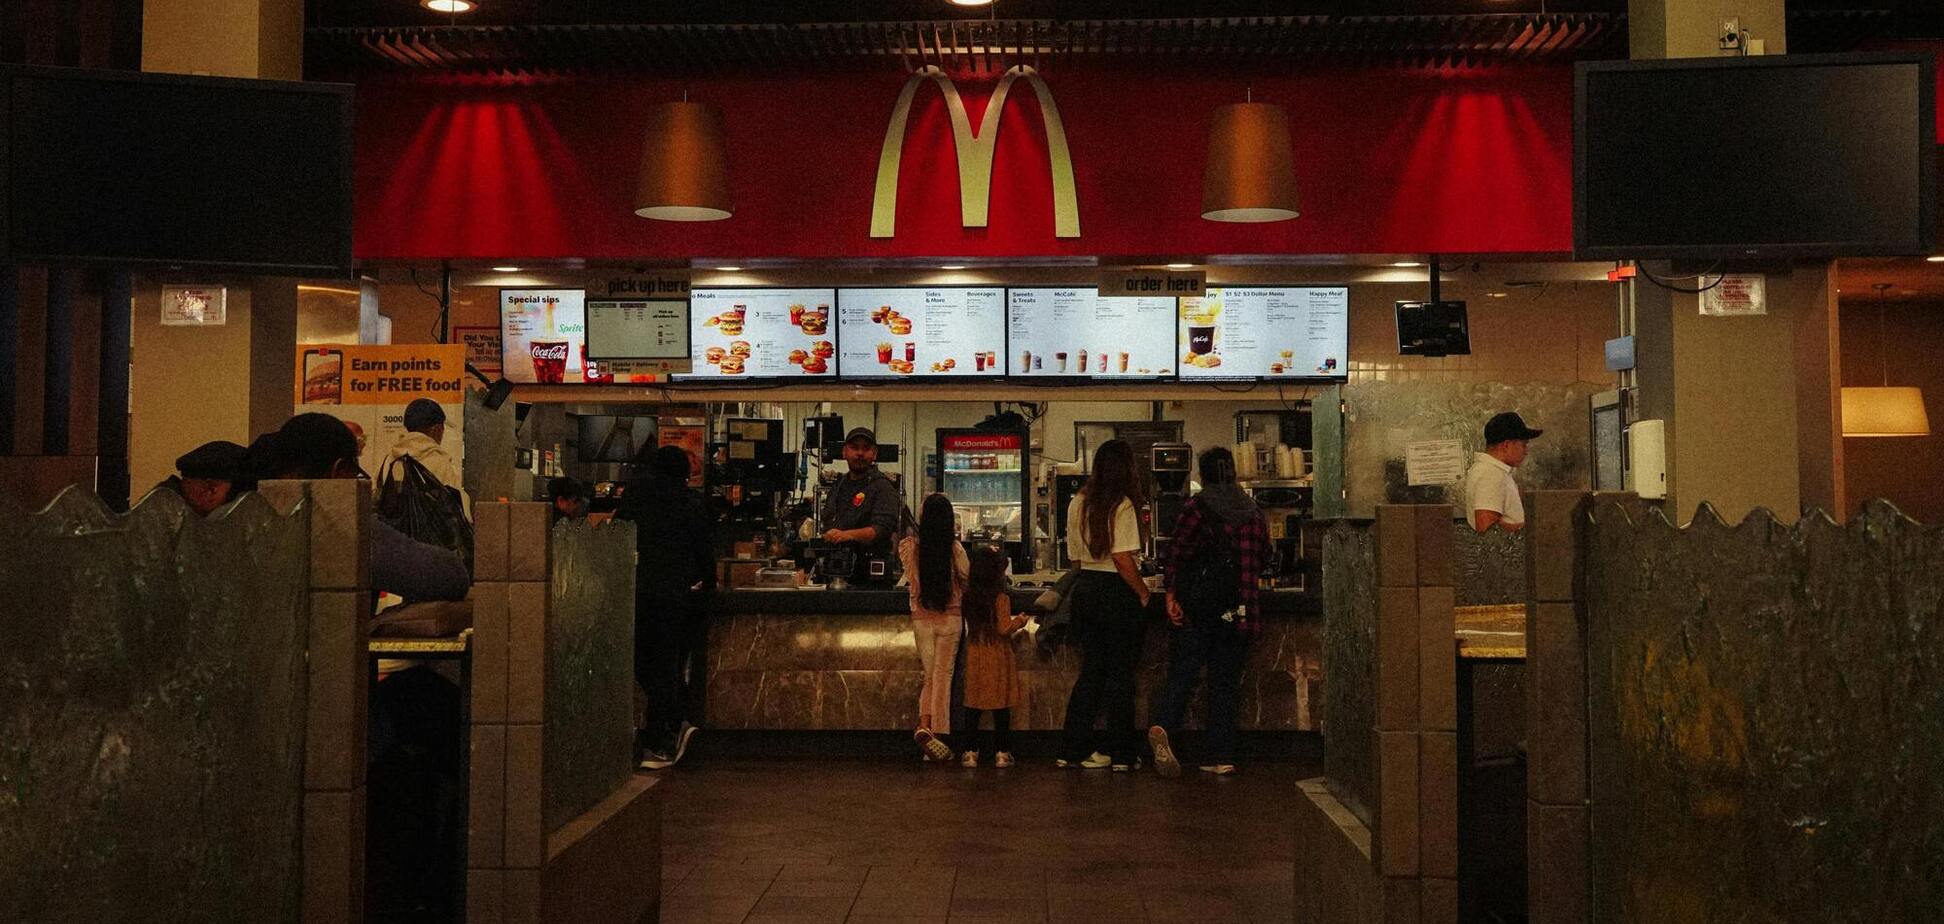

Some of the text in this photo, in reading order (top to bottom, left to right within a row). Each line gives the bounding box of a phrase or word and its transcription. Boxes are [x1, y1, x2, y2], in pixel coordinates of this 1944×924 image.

[608, 277, 689, 297] pick up here
[1126, 276, 1199, 291] order here
[508, 295, 561, 305] Special sips
[1207, 291, 1217, 299] joy
[1309, 291, 1328, 299] Happy
[352, 357, 441, 374] Earn points
[350, 377, 461, 391] for FREE food
[383, 415, 403, 423] 3000
[953, 440, 1000, 448] McDonald's
